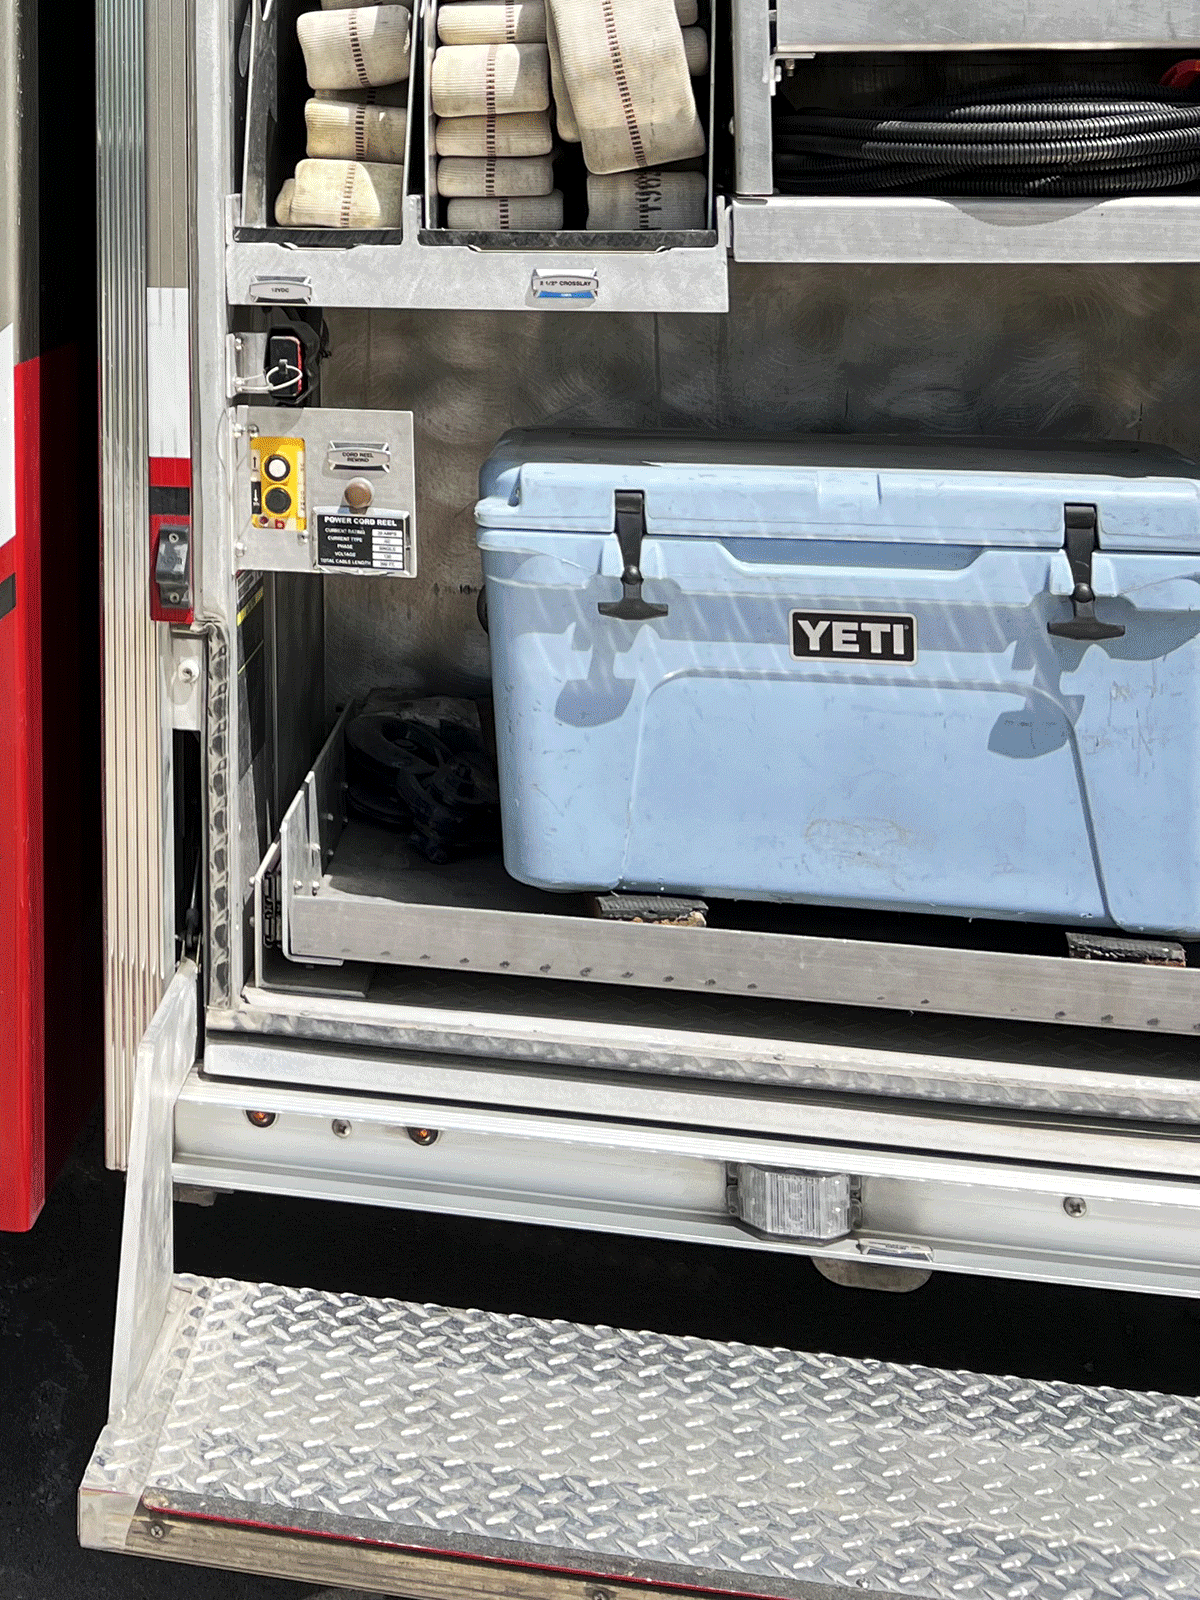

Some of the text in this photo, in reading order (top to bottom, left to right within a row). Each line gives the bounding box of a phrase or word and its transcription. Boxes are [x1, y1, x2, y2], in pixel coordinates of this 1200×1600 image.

[324, 516, 397, 526] POWER CORD REEL
[797, 619, 905, 655] YETI
